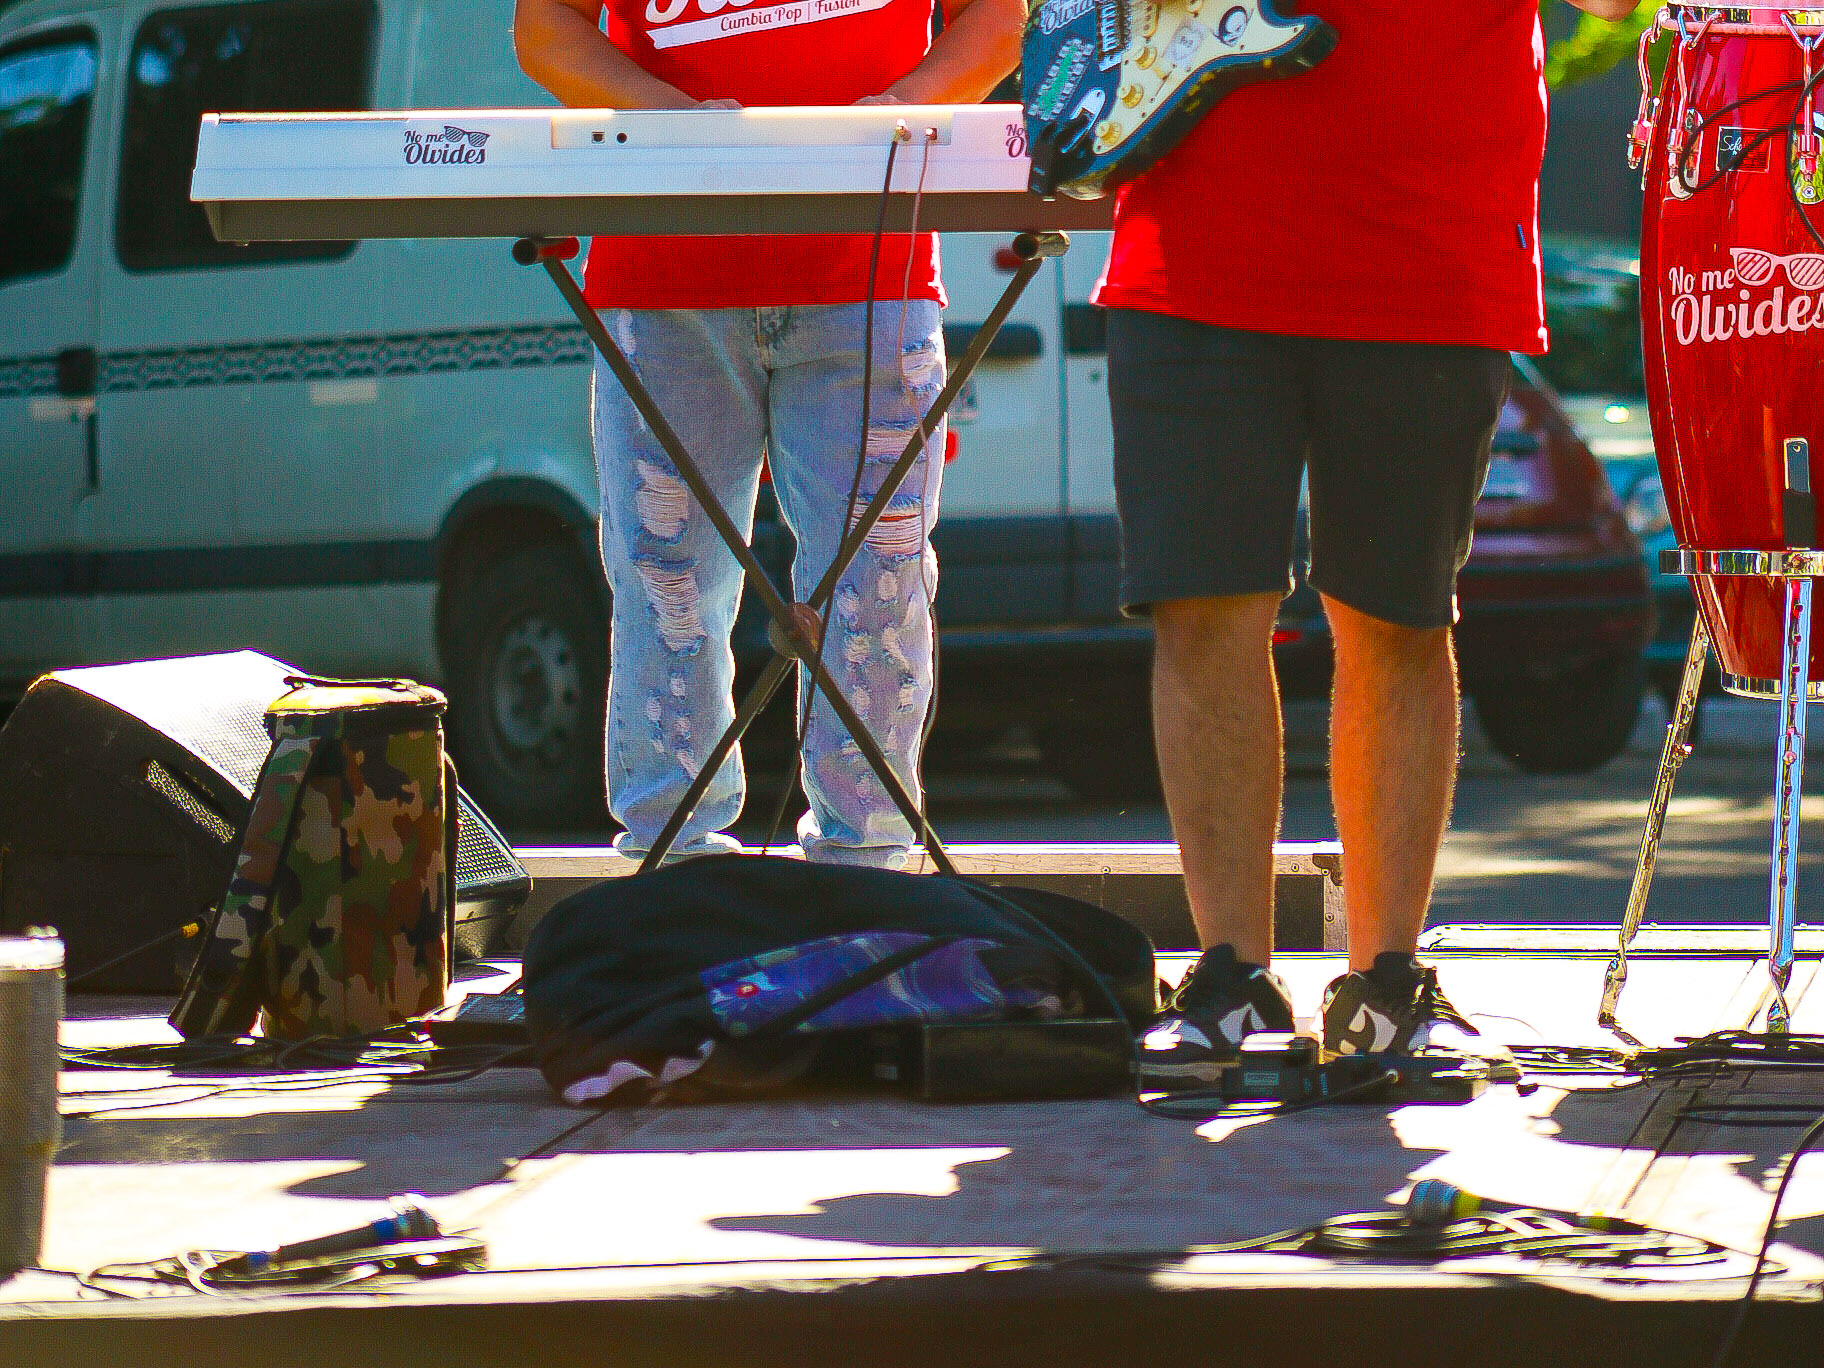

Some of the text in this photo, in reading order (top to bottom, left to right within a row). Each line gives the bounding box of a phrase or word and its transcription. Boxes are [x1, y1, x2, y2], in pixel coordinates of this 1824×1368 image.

[720, 11, 772, 31] Cumbia
[775, 6, 802, 23] Pop
[404, 130, 446, 144] No me
[403, 143, 486, 165] Olvides
[1668, 266, 1736, 296] No me
